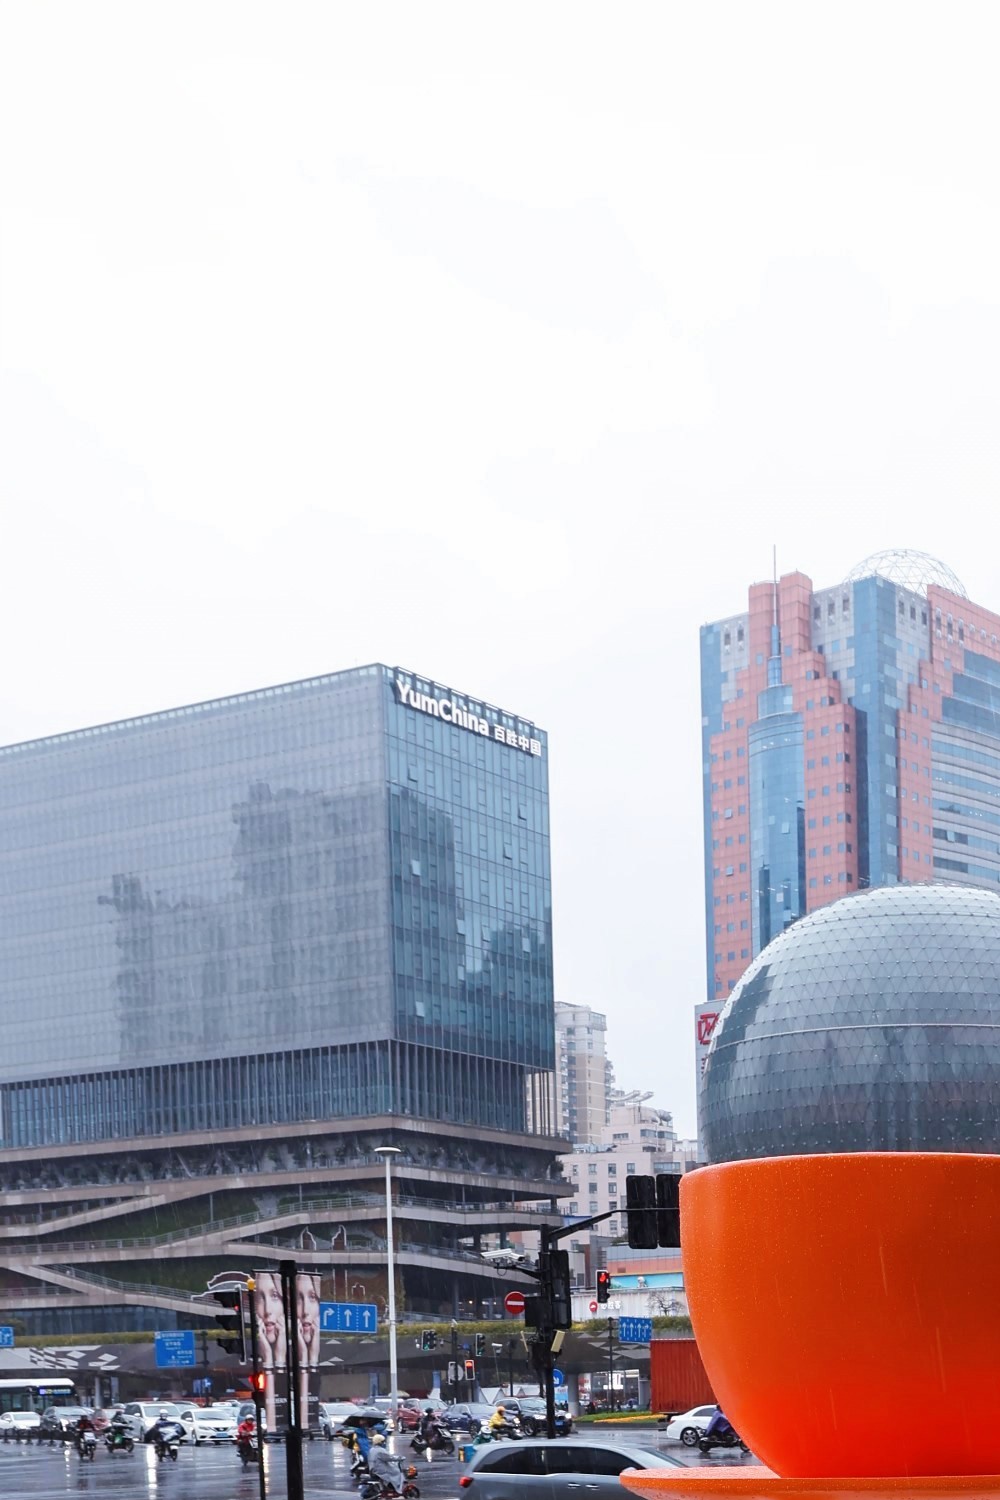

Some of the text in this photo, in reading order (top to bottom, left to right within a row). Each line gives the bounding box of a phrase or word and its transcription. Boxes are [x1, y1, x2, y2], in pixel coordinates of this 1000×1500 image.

[396, 679, 541, 757] YumChina 百胜中国
